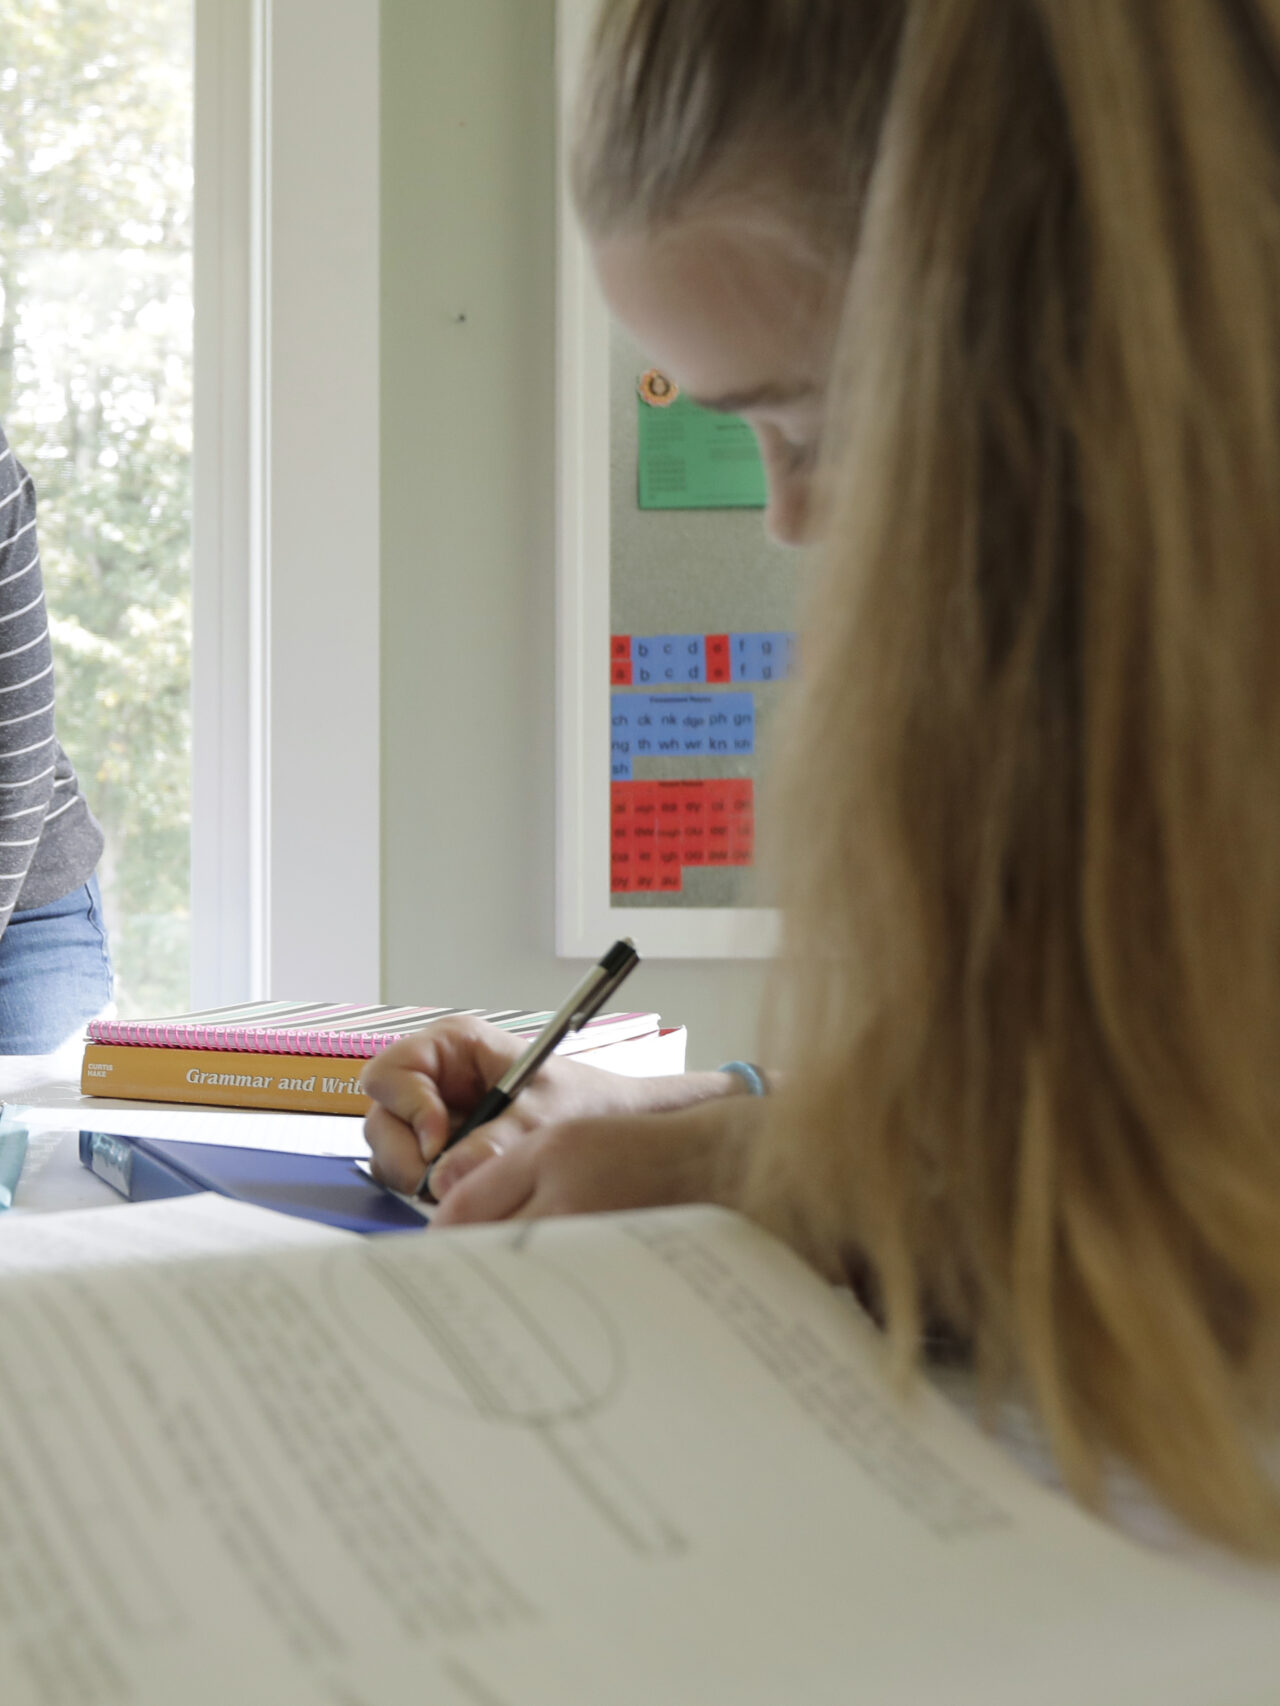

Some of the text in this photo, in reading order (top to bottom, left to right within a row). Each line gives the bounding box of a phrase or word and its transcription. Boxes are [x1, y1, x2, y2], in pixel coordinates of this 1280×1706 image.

[638, 643, 648, 657] b
[663, 643, 671, 654] c
[687, 641, 698, 655] d
[739, 639, 745, 653] f
[761, 641, 772, 656] g
[639, 669, 650, 682] b
[664, 667, 673, 679] c
[688, 665, 699, 680] d
[740, 664, 746, 677] f
[762, 666, 772, 681] g
[611, 713, 628, 726] ch
[637, 713, 652, 726] ck
[661, 713, 676, 726] nk
[709, 712, 727, 727] ph
[733, 713, 751, 727] gn
[610, 739, 629, 753] ng
[637, 737, 651, 751] th
[658, 737, 679, 751] wh
[684, 738, 702, 751] wr
[709, 736, 727, 751] kn
[611, 763, 628, 776] sh
[87, 1063, 113, 1071] CURTIS
[87, 1070, 107, 1078] HAKE
[185, 1068, 273, 1089] Grammar
[277, 1075, 315, 1093] and
